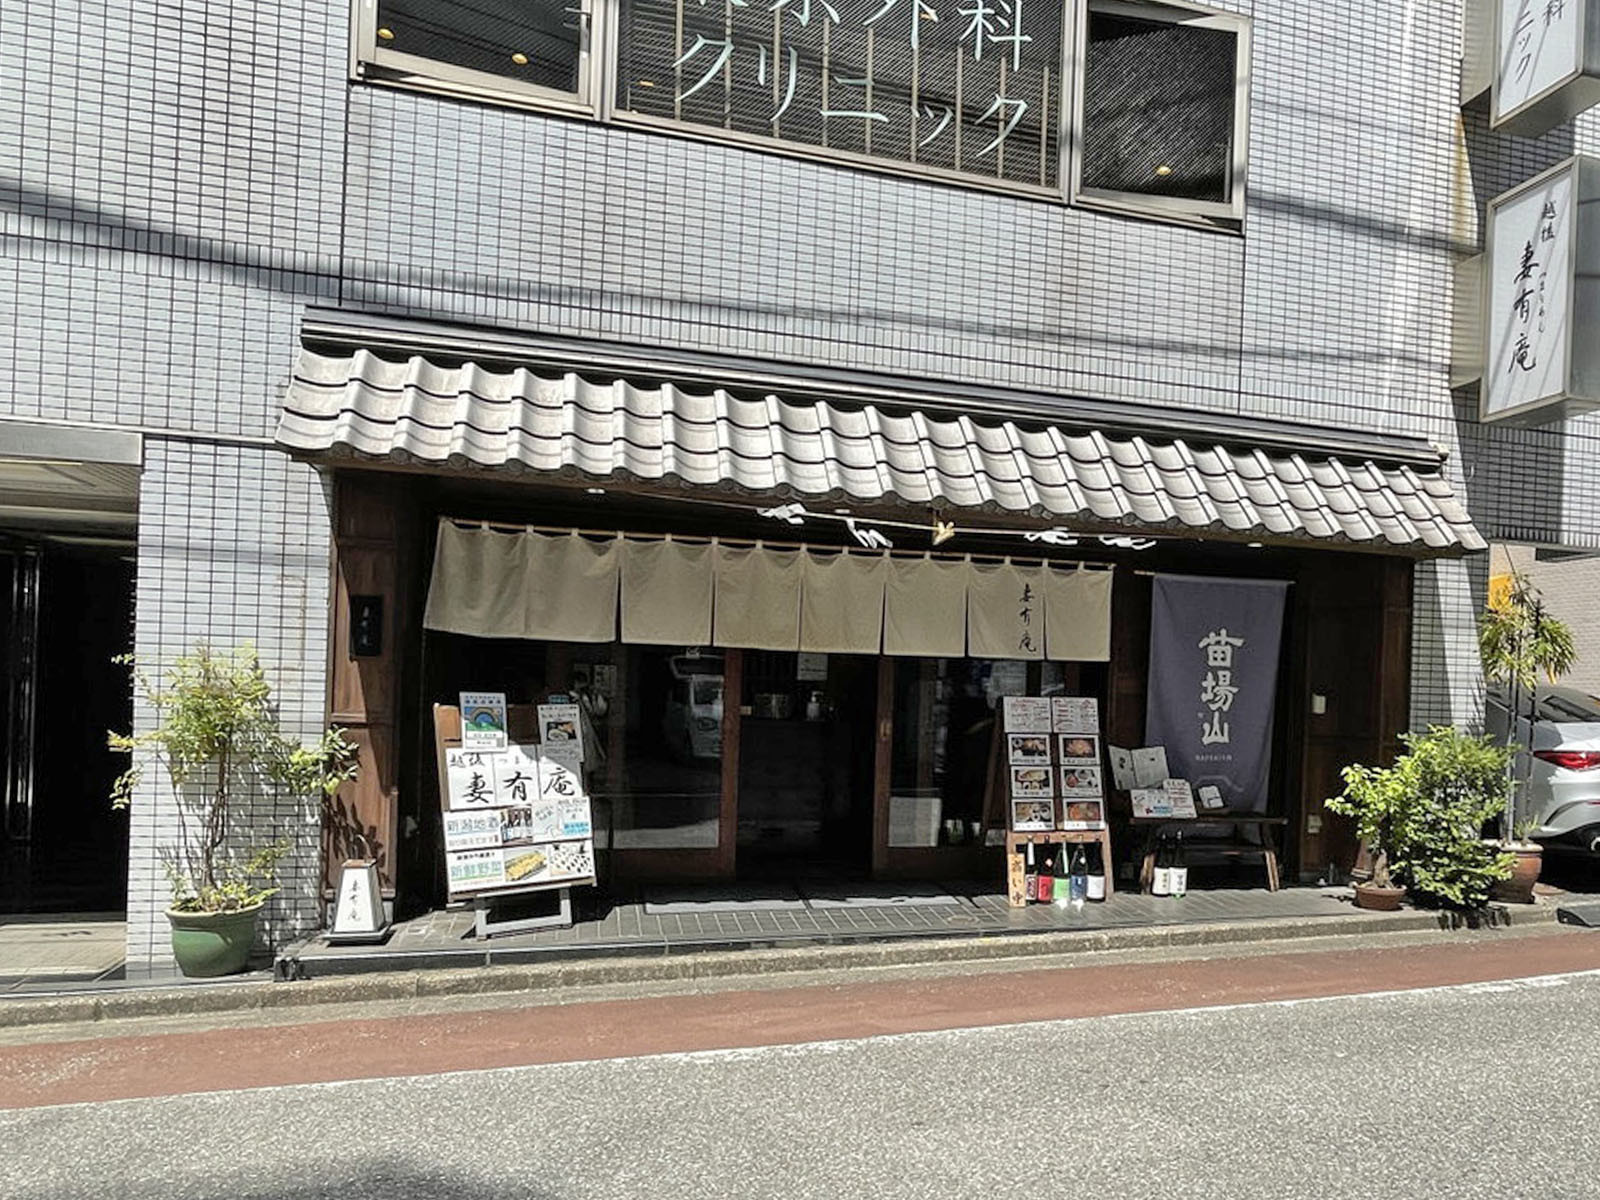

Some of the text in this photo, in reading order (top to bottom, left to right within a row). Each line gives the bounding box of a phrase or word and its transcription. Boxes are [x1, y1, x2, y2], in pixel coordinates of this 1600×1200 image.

[671, 34, 1029, 157] クリニック
[1508, 240, 1540, 373] 妻有庵
[1018, 583, 1037, 653] 妻有庵
[1198, 628, 1245, 746] 苗場山
[463, 767, 576, 804] 妻有庵
